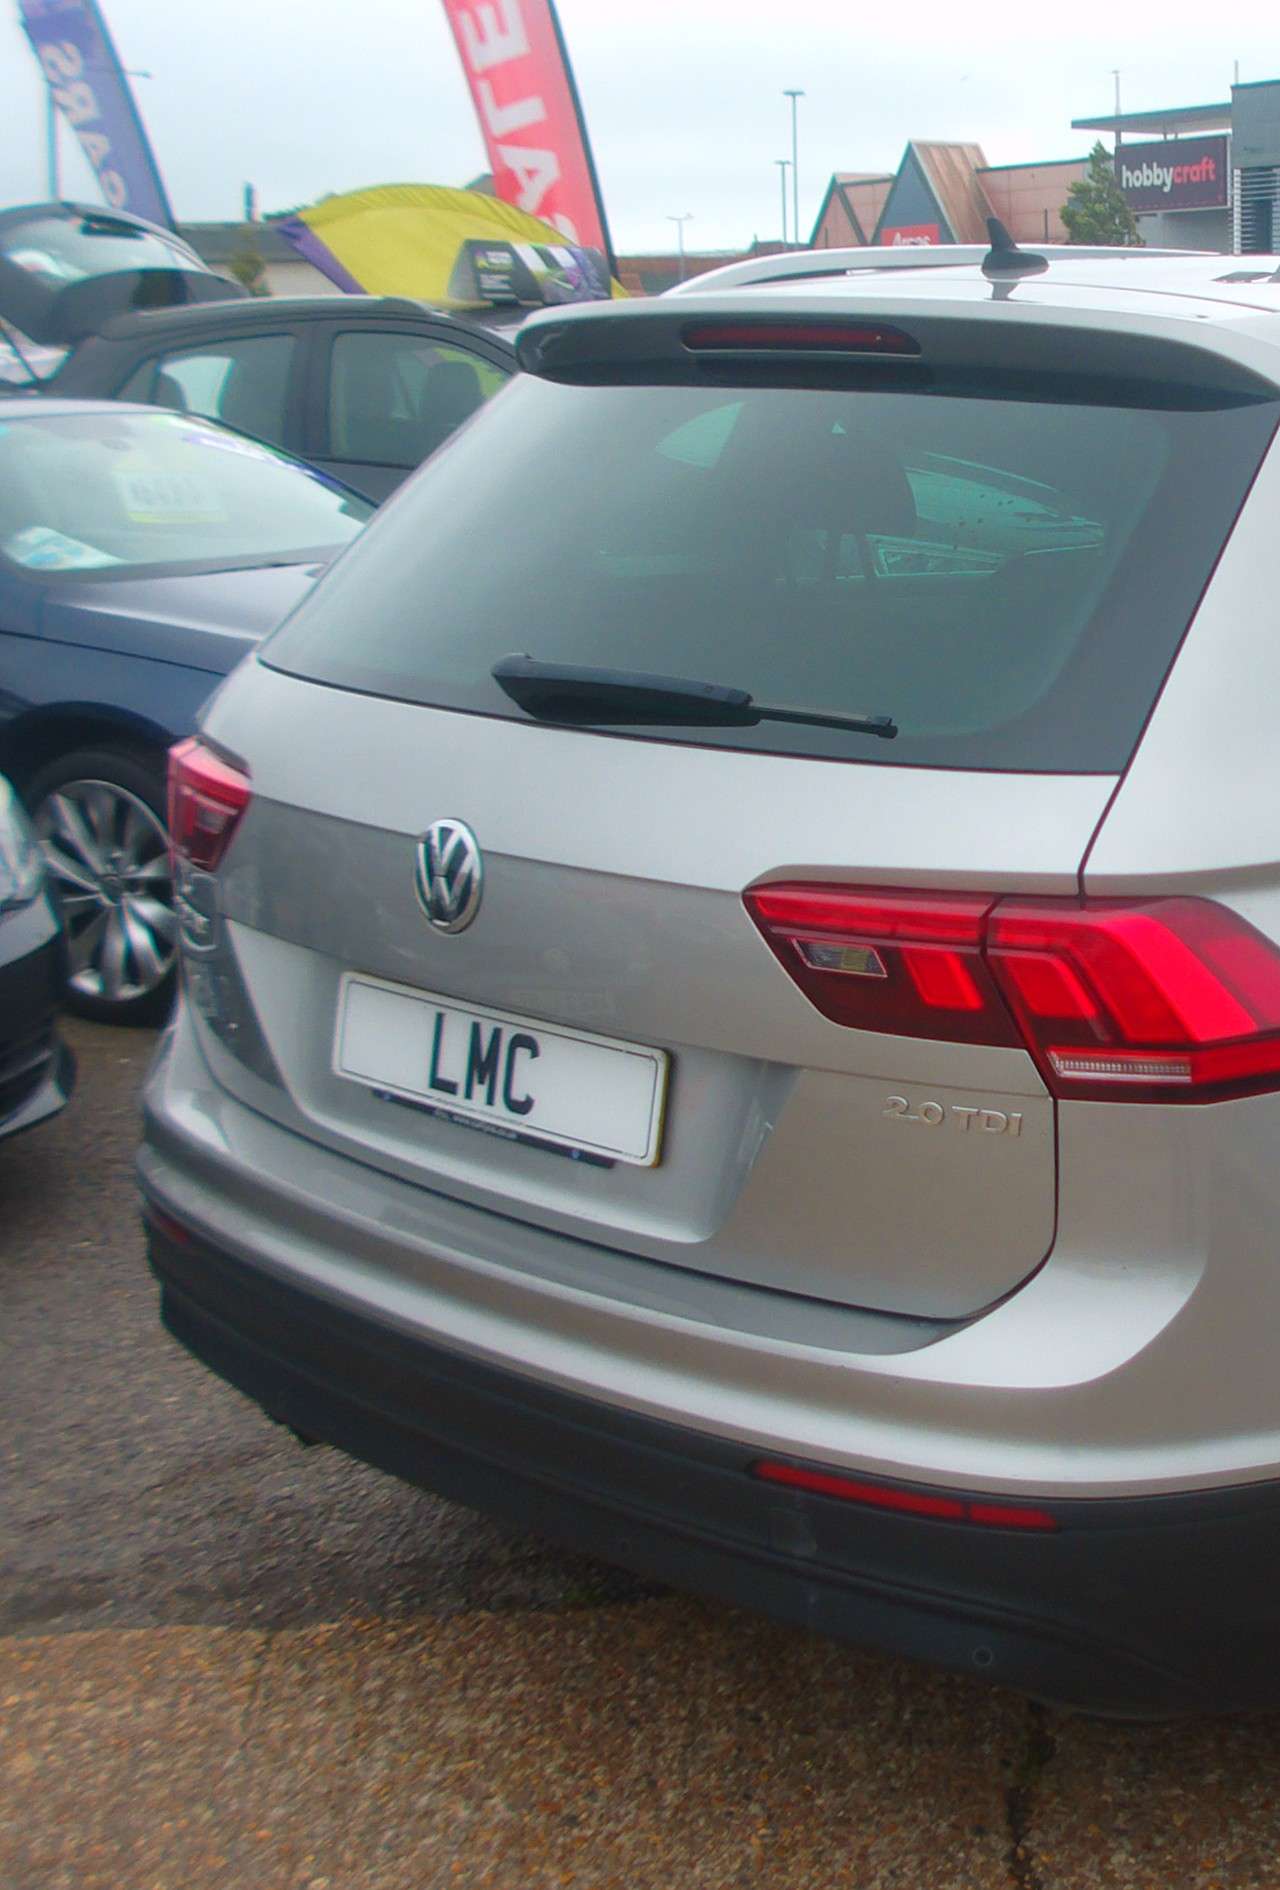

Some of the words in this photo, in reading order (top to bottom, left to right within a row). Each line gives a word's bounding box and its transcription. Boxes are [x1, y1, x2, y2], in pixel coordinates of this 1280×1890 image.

[1121, 157, 1217, 192] hobbycraft
[429, 1011, 540, 1115] LMC
[951, 1104, 1023, 1137] TDI
